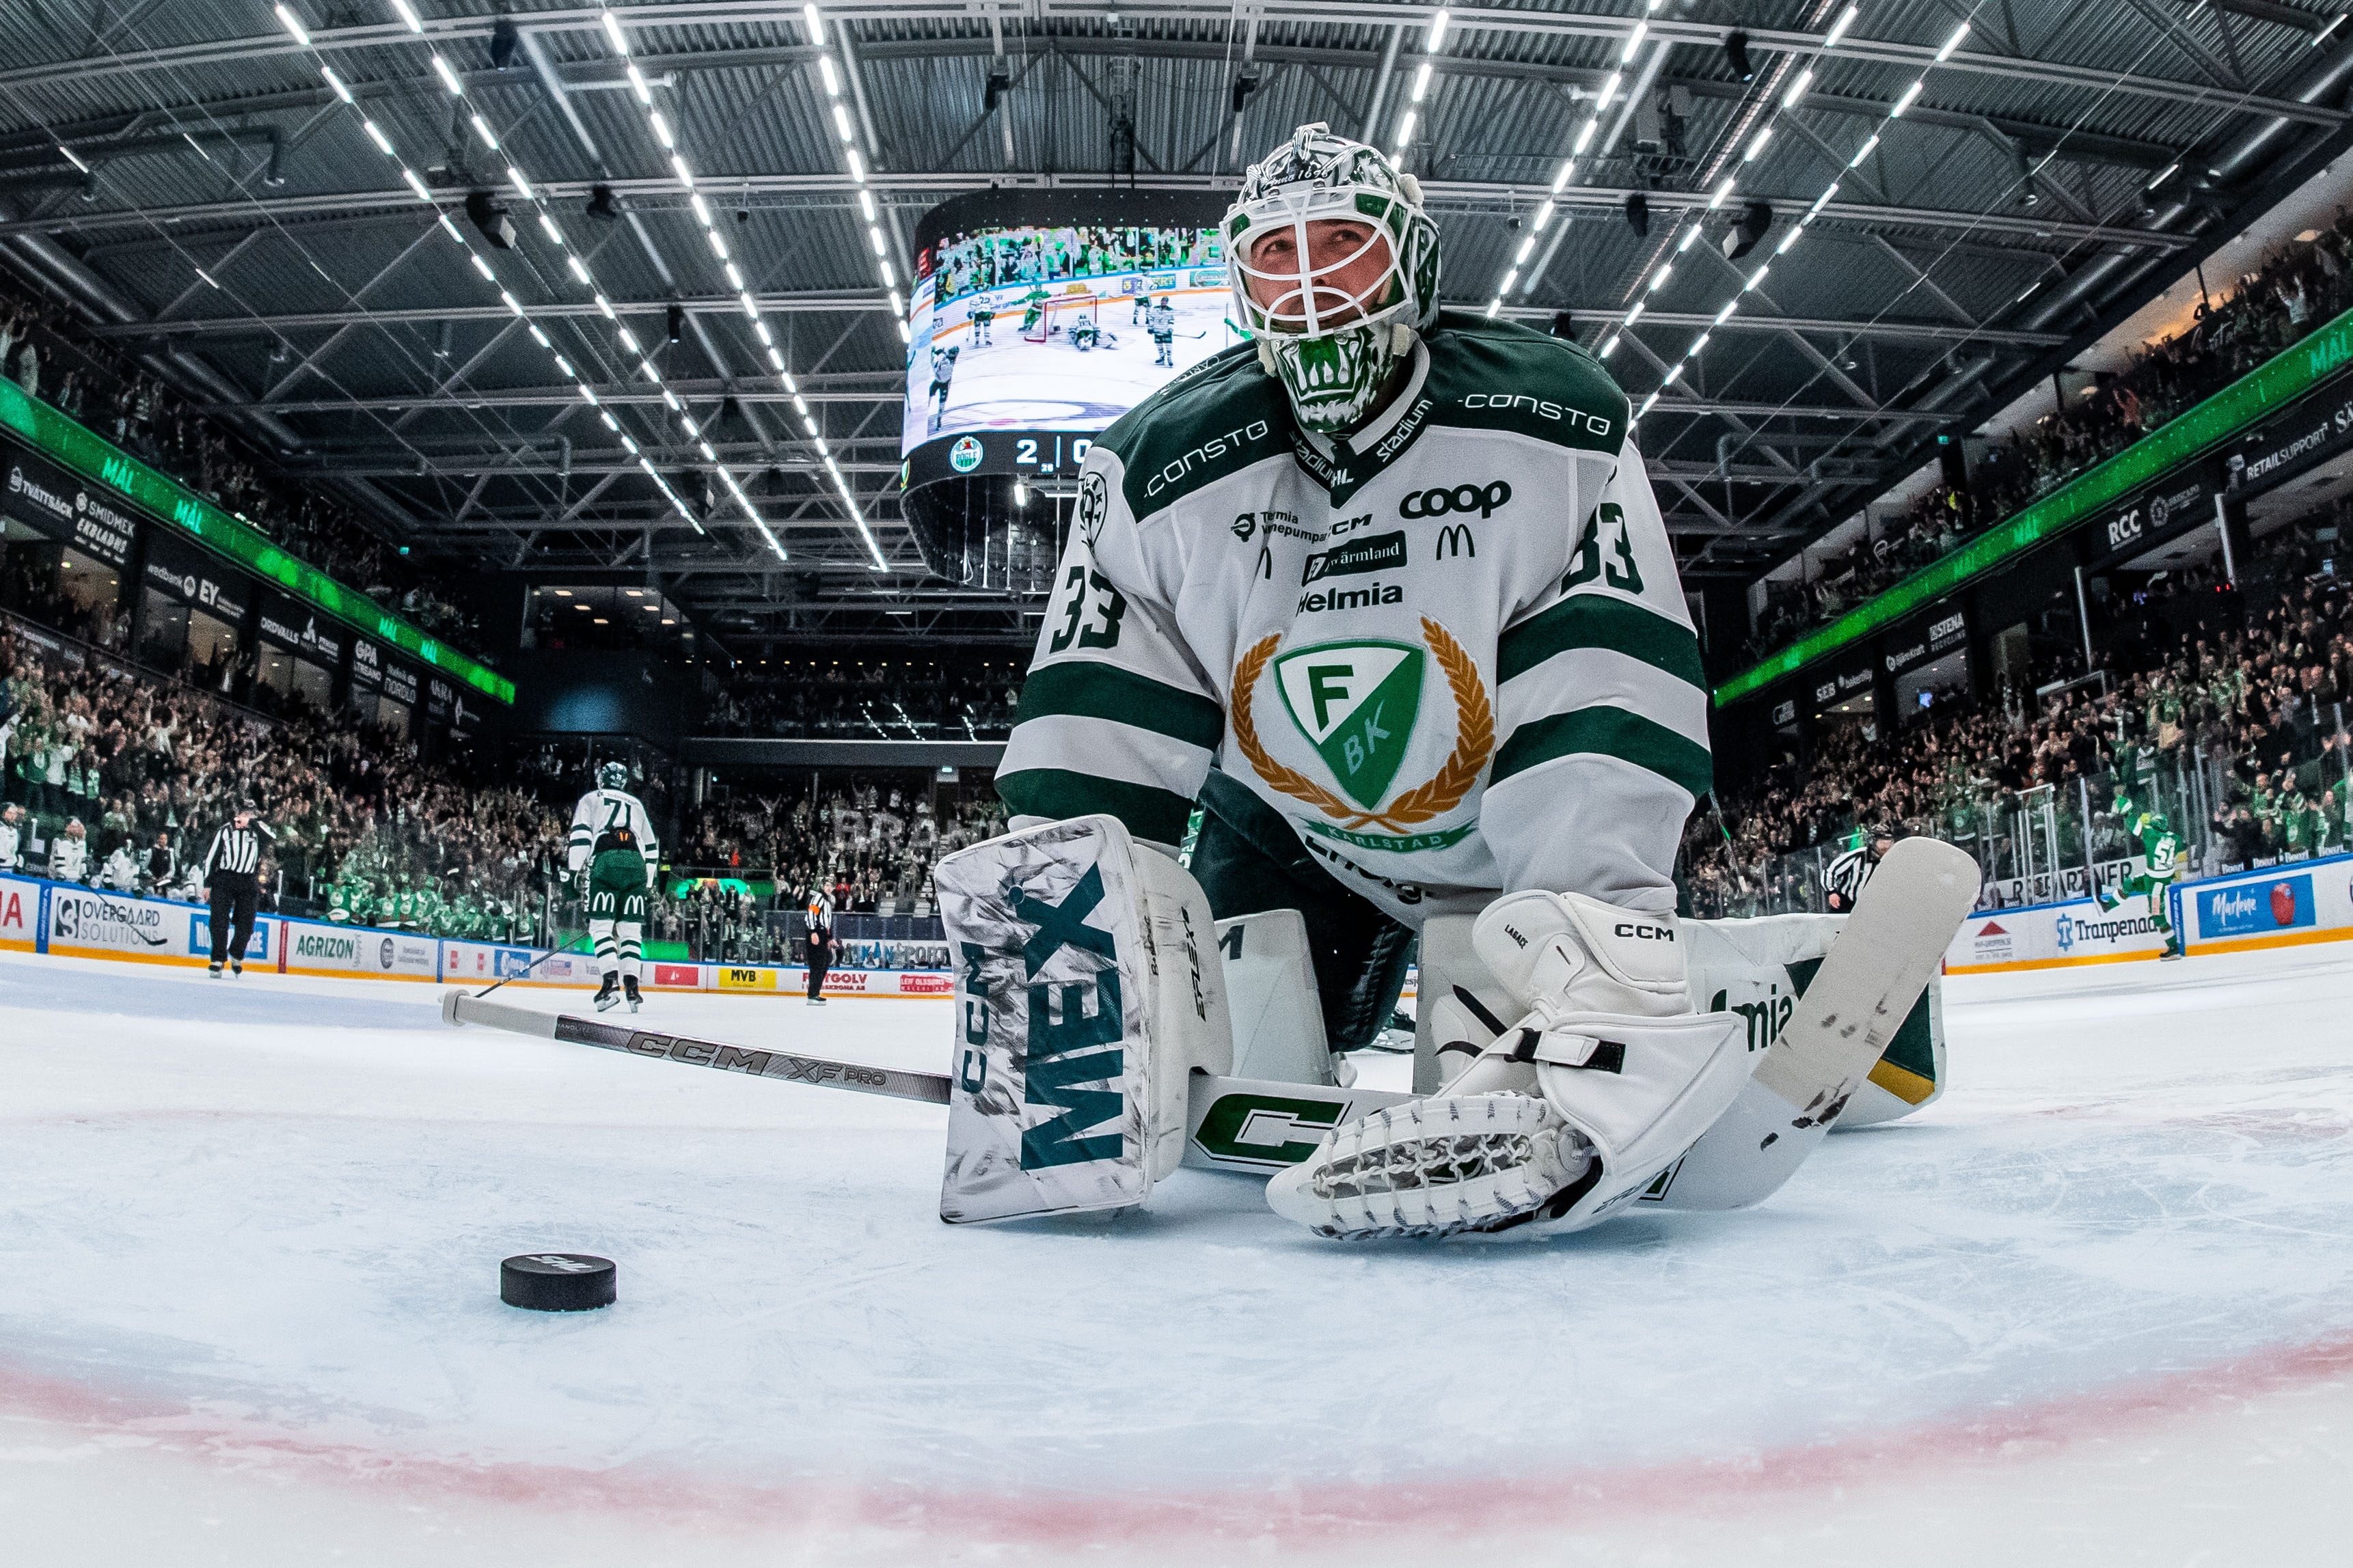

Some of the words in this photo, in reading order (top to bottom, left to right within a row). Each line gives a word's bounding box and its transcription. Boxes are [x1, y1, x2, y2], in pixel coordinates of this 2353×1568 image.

[1376, 399, 1433, 463] Stadium
[103, 456, 135, 495] MÅL
[174, 499, 202, 535] MÅL
[1398, 480, 1512, 519] coop
[1329, 514, 1373, 536] CM
[2108, 509, 2141, 545] RCC
[1330, 542, 1400, 566] ärmland
[200, 579, 220, 606] EY
[1049, 565, 1128, 655] 33
[1307, 664, 1355, 733] F
[603, 797, 631, 833] 71
[1327, 825, 1446, 851] KARLSTAD
[83, 900, 161, 927] OVERGAARD
[80, 921, 160, 946] SOLUTIONS
[296, 934, 355, 960] AGRIZON
[1614, 924, 1675, 942] CCM
[731, 969, 757, 982] MVB
[961, 941, 990, 1093] CCM
[627, 1030, 772, 1076] CCM
[788, 1056, 844, 1084] XF
[844, 1069, 886, 1086] PRO
